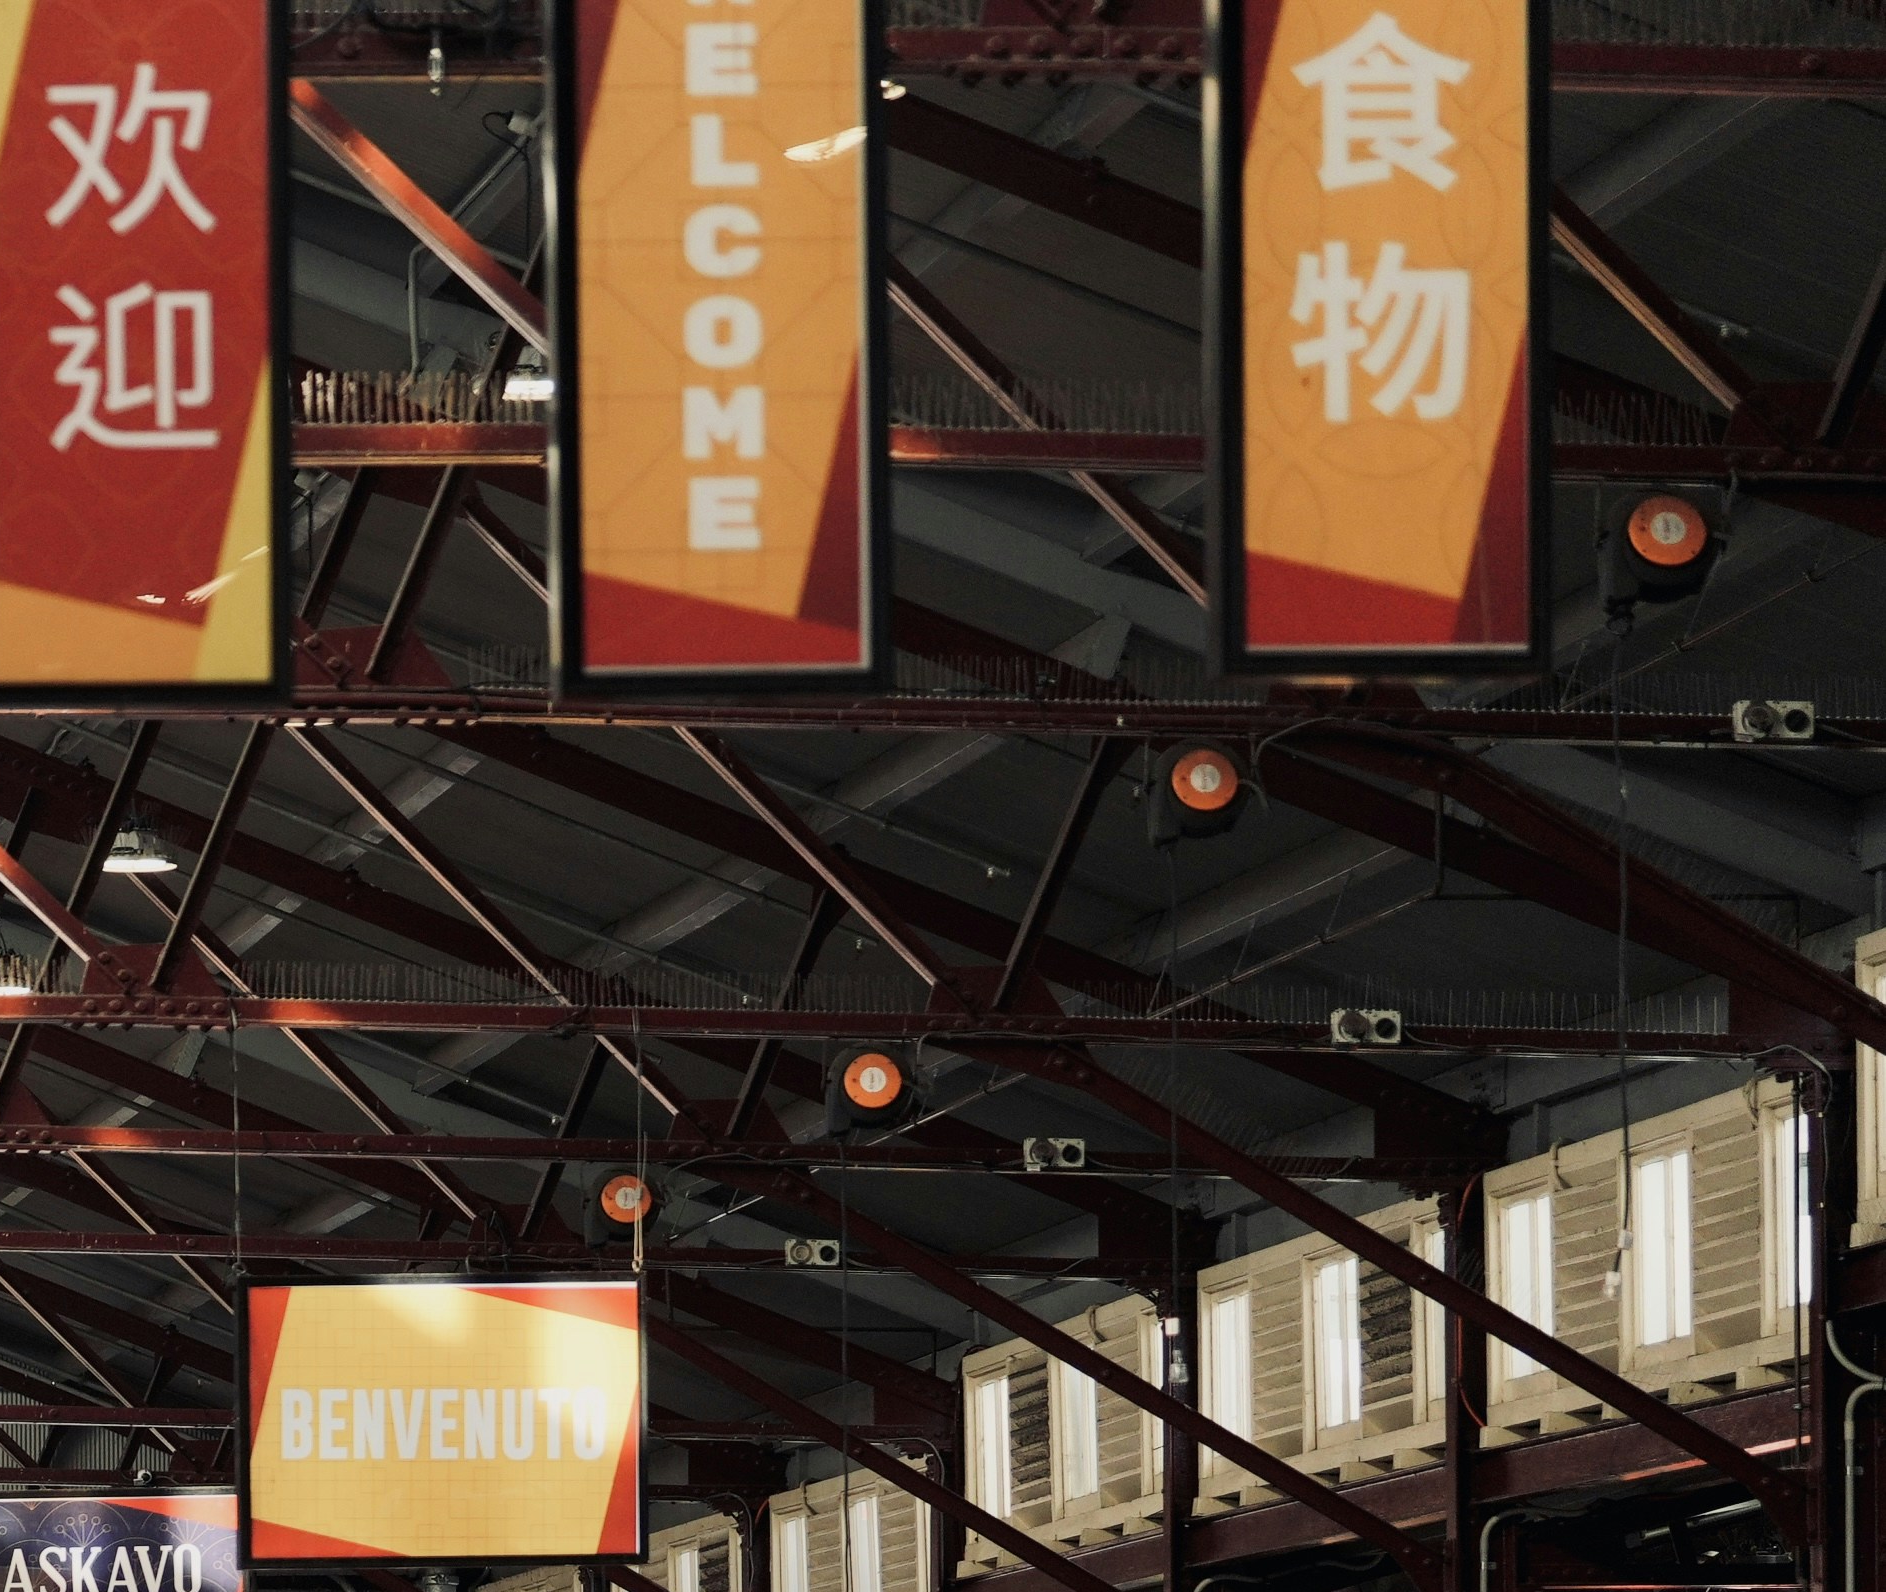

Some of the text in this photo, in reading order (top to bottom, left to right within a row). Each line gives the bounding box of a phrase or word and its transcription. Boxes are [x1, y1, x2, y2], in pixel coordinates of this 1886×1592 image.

[43, 61, 220, 452] 欢迎
[681, 0, 765, 553] ELCOME
[1288, 9, 1474, 424] 食物
[280, 1386, 606, 1462] BENVENUTO
